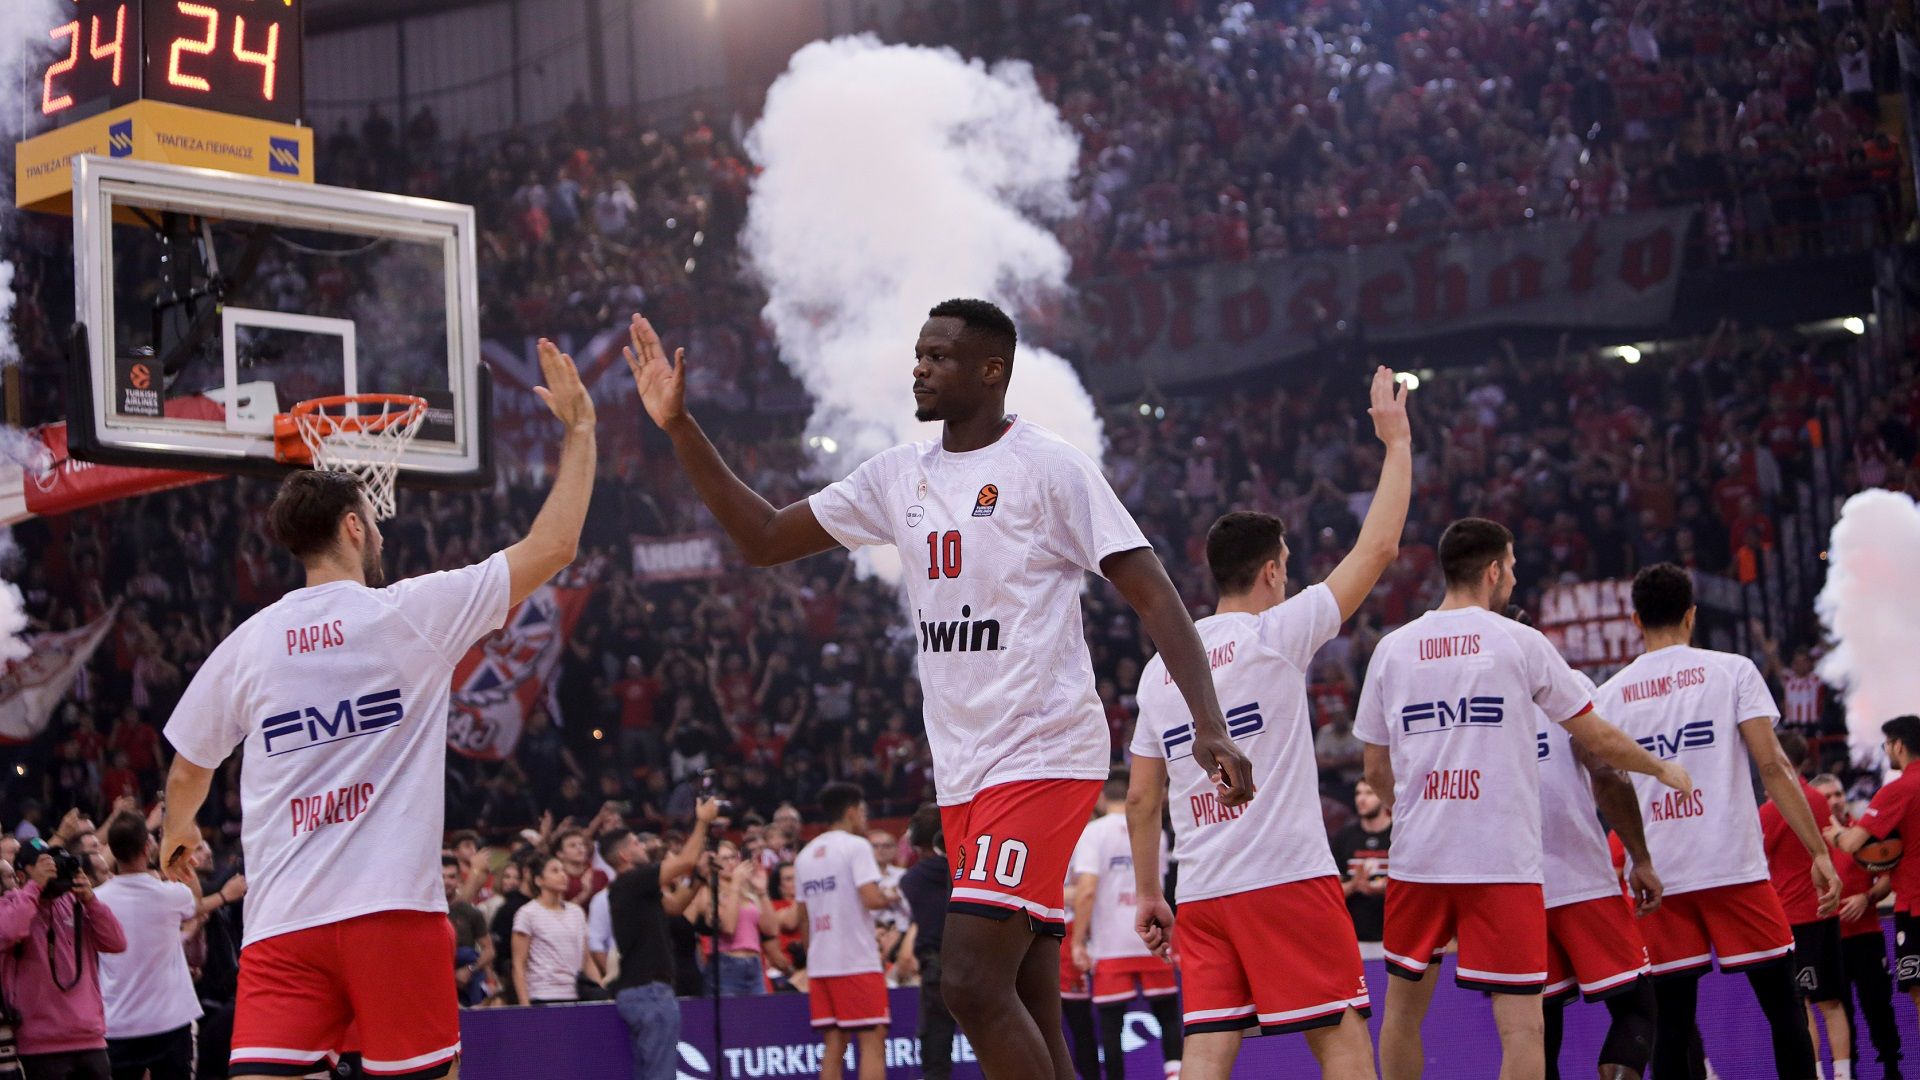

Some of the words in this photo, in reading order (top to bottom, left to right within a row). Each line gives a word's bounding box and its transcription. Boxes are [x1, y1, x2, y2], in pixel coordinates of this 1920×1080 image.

[42, 4, 126, 114] 24
[169, 1, 279, 101] 24
[155, 132, 203, 151] ΤΡΑΠΕΖΑ
[927, 530, 961, 579] 10
[286, 620, 344, 655] PAPAS
[1420, 634, 1480, 661] LOUNTZIS
[1621, 666, 1705, 704] WILLIAMS-GOSS
[262, 689, 404, 753] FMS
[1163, 702, 1264, 758] FS
[1402, 696, 1504, 732] FMS
[291, 782, 374, 837] PIRAEUS
[969, 834, 1029, 888] 10
